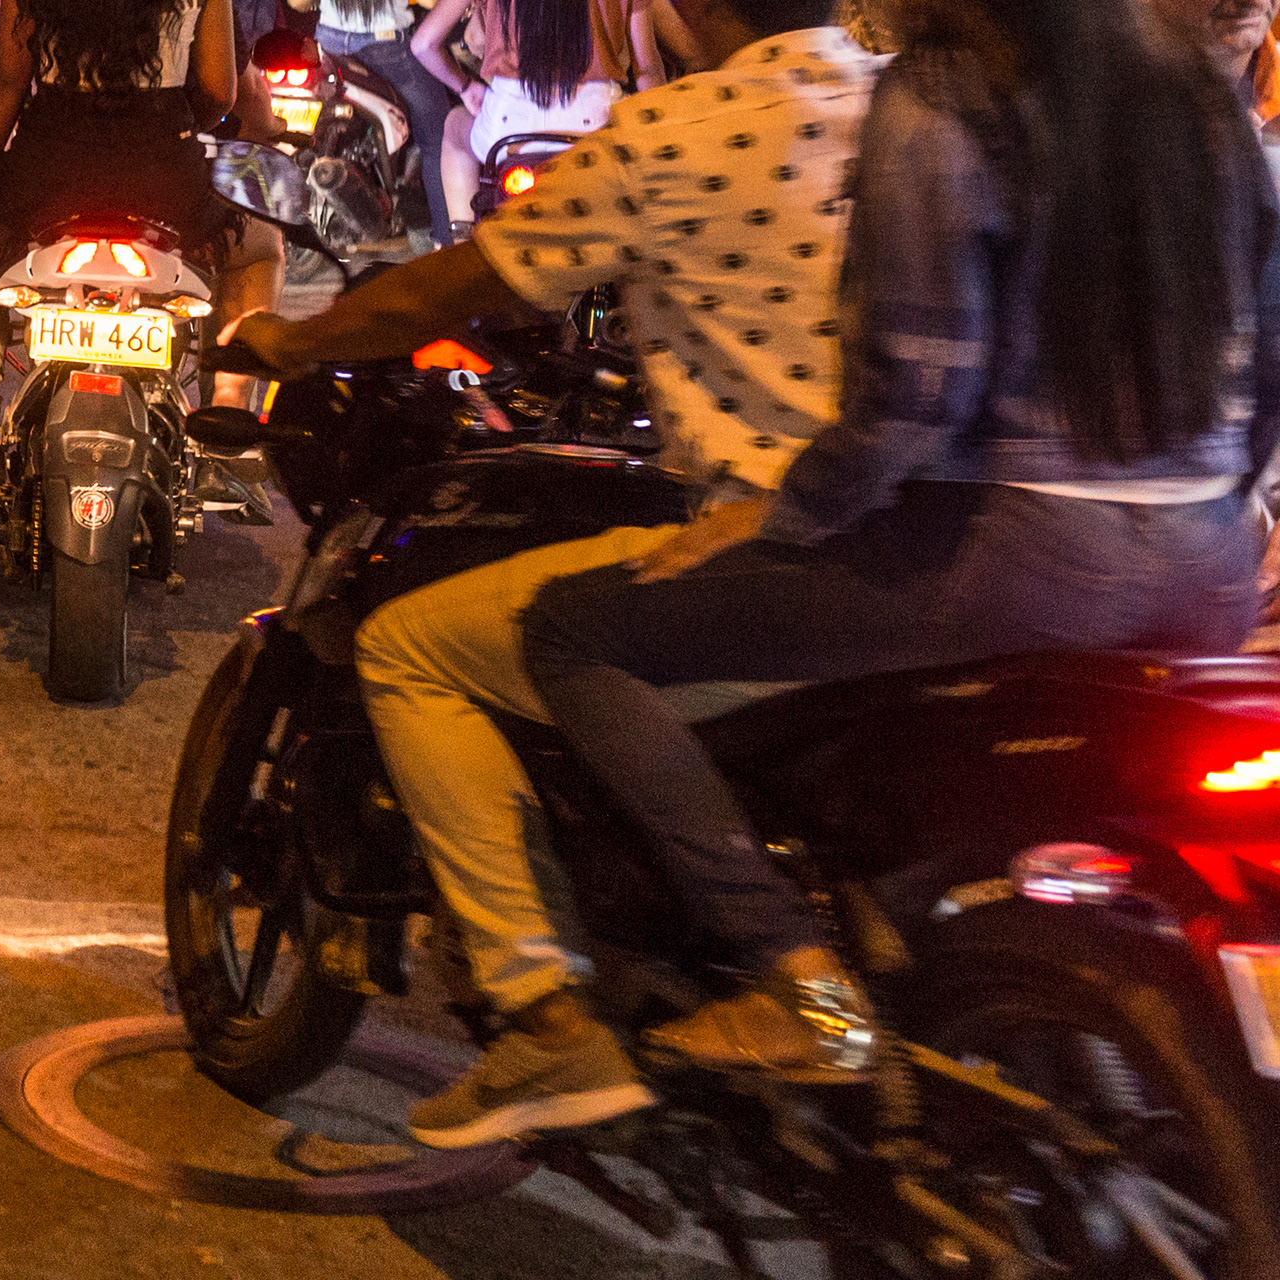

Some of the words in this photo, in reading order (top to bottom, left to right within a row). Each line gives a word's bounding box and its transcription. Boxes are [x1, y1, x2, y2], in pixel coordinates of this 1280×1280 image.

[39, 317, 95, 348] HRW
[108, 323, 163, 353] 46C
[79, 498, 105, 516] #1
